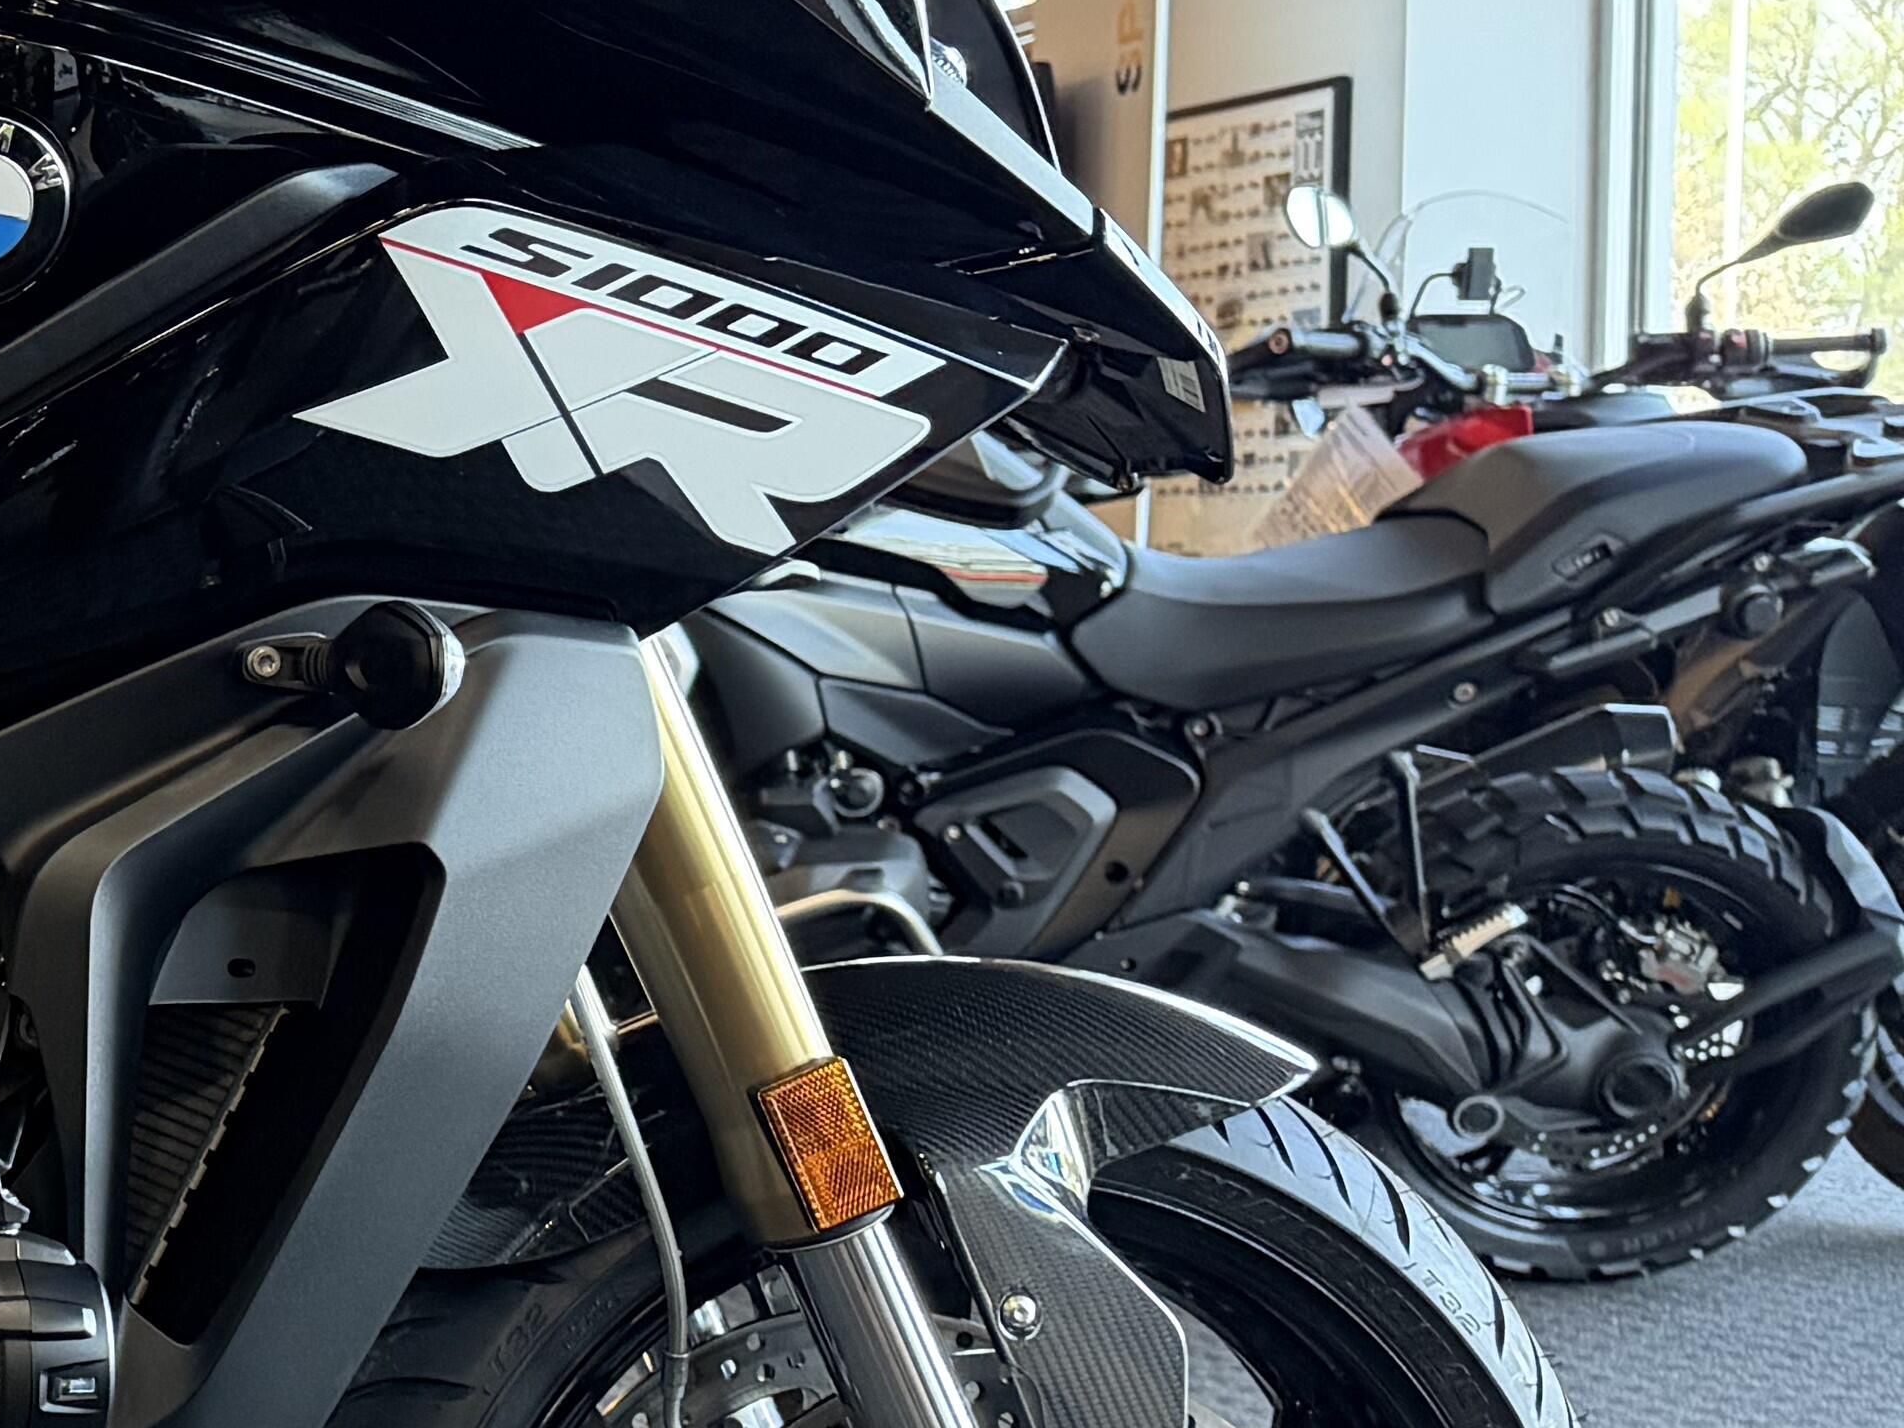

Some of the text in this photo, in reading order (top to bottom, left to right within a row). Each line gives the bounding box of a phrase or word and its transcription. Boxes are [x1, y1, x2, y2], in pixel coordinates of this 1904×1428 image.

[460, 227, 890, 376] S1000
[294, 245, 932, 557] XR
[1419, 1267, 1482, 1338] T32
